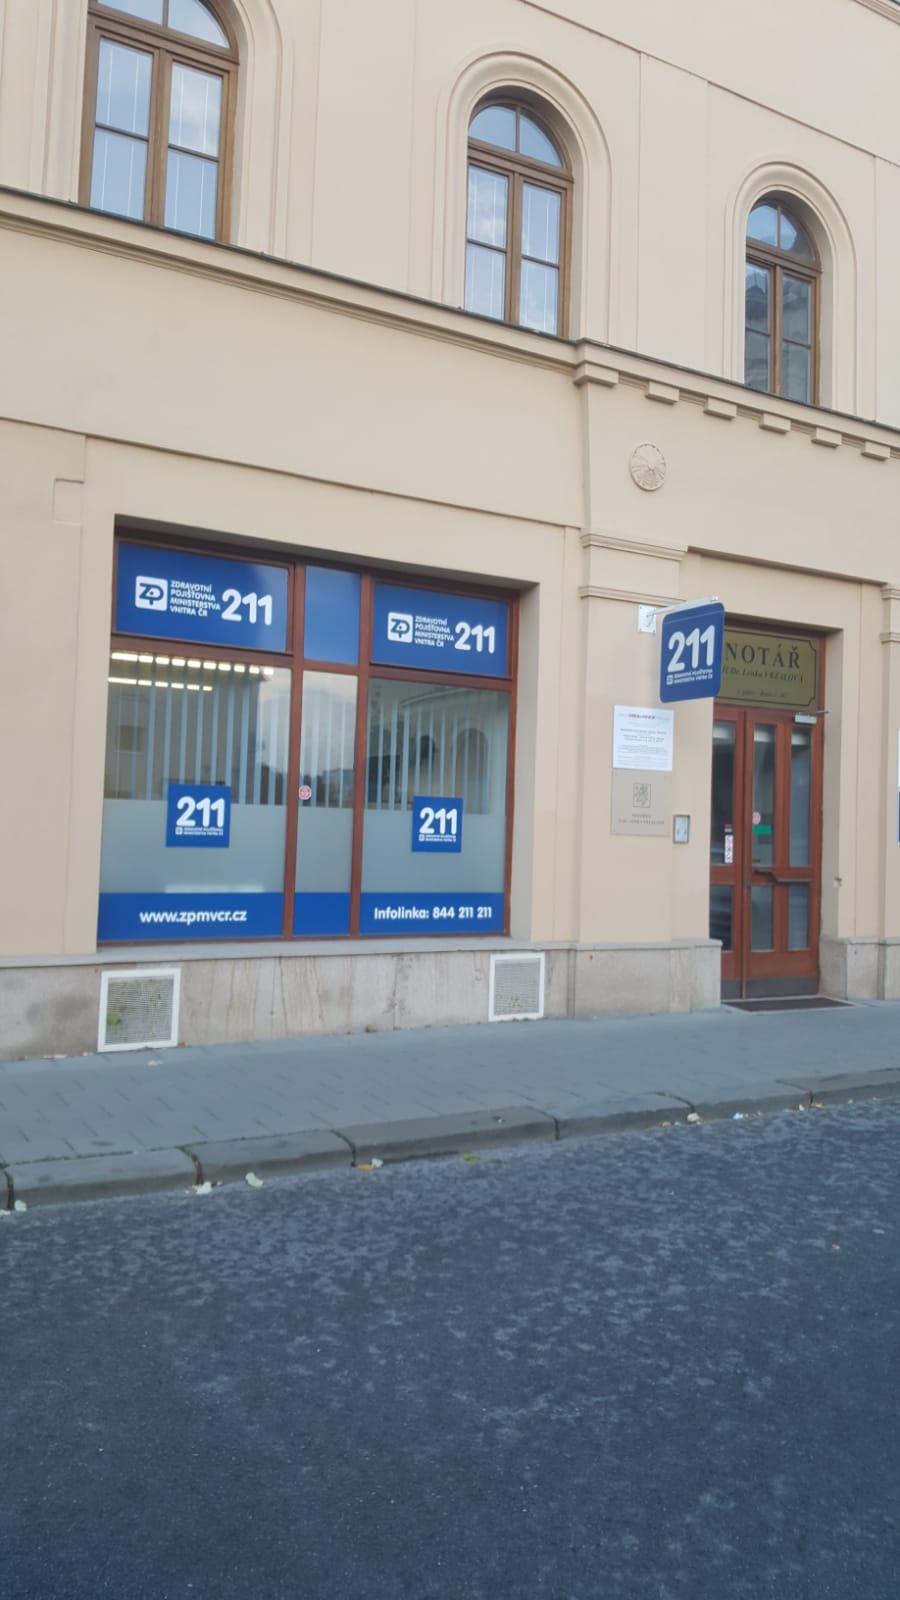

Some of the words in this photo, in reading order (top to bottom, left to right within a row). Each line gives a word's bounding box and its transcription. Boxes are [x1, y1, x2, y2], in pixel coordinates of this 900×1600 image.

[170, 580, 213, 593] ZDRAVOTNÍ
[169, 598, 221, 611] MINISTERSTVA
[169, 606, 197, 616] VNITRA
[197, 607, 208, 617] ČR
[221, 588, 273, 626] 211
[454, 621, 496, 654] 211
[667, 624, 716, 673] 211
[726, 642, 800, 669] NOTÁŘ
[176, 795, 225, 828] 211
[419, 807, 458, 834] 211
[139, 910, 248, 926] www.zpmvcr.cz
[373, 905, 430, 920] Infolinka:
[432, 906, 455, 919] 844
[458, 906, 474, 919] 211
[477, 906, 493, 919] 211
